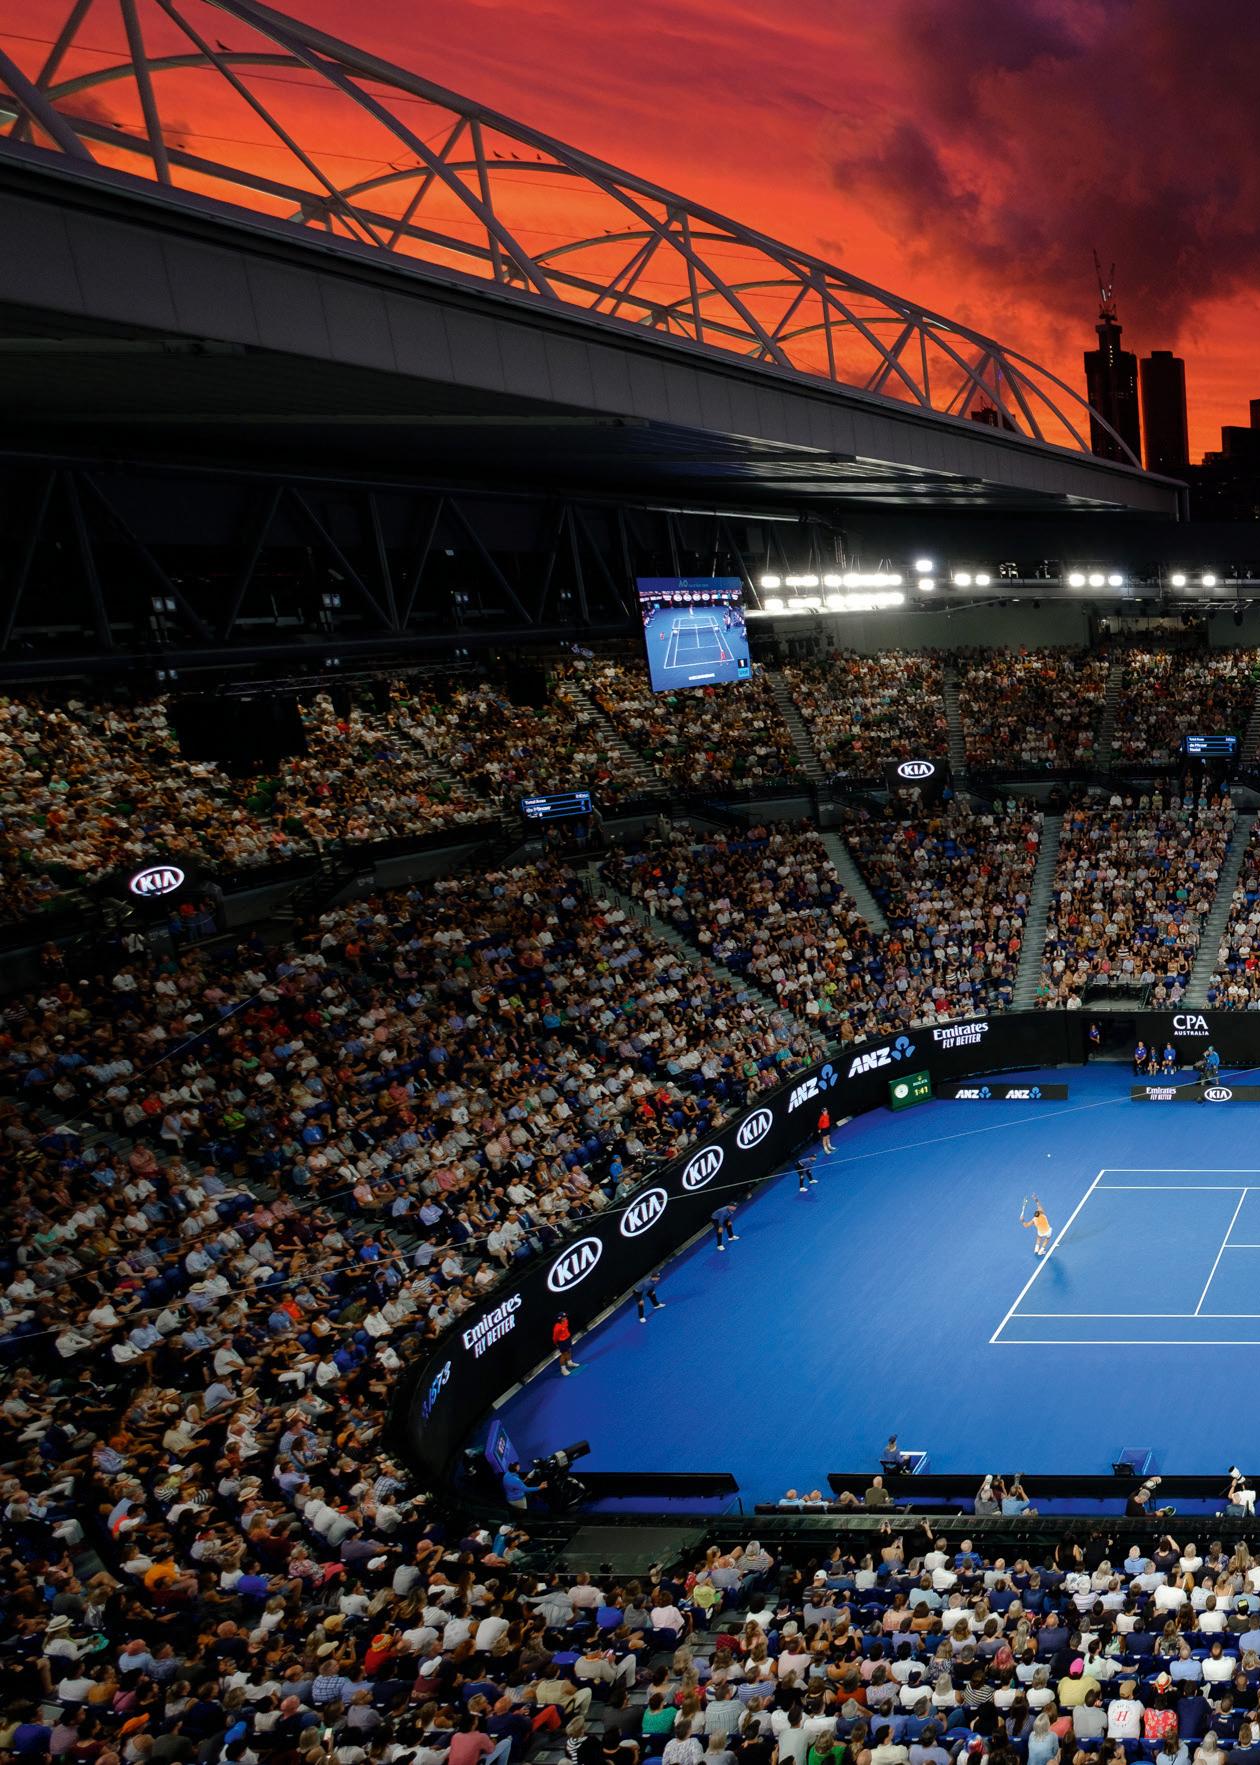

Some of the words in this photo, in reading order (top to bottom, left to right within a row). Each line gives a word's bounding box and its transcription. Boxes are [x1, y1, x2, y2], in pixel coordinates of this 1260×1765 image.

[904, 764, 929, 775] KIA
[140, 871, 176, 892] KIA
[933, 1022, 988, 1040] Emirates
[1173, 1015, 1209, 1030] CPA
[943, 1038, 954, 1048] FLY
[956, 1033, 981, 1046] BETTER
[848, 1047, 891, 1078] ANZ
[788, 1077, 819, 1113] ANZ
[955, 1090, 979, 1099] ANZ
[1005, 1090, 1030, 1099] ANZ
[743, 1115, 767, 1145] KIA
[689, 1151, 718, 1186] KIA
[628, 1194, 661, 1231] KIA
[556, 1243, 594, 1287] KIA
[462, 1293, 522, 1350] Emirates
[475, 1336, 486, 1358] FLY
[487, 1314, 515, 1346] BETTER
